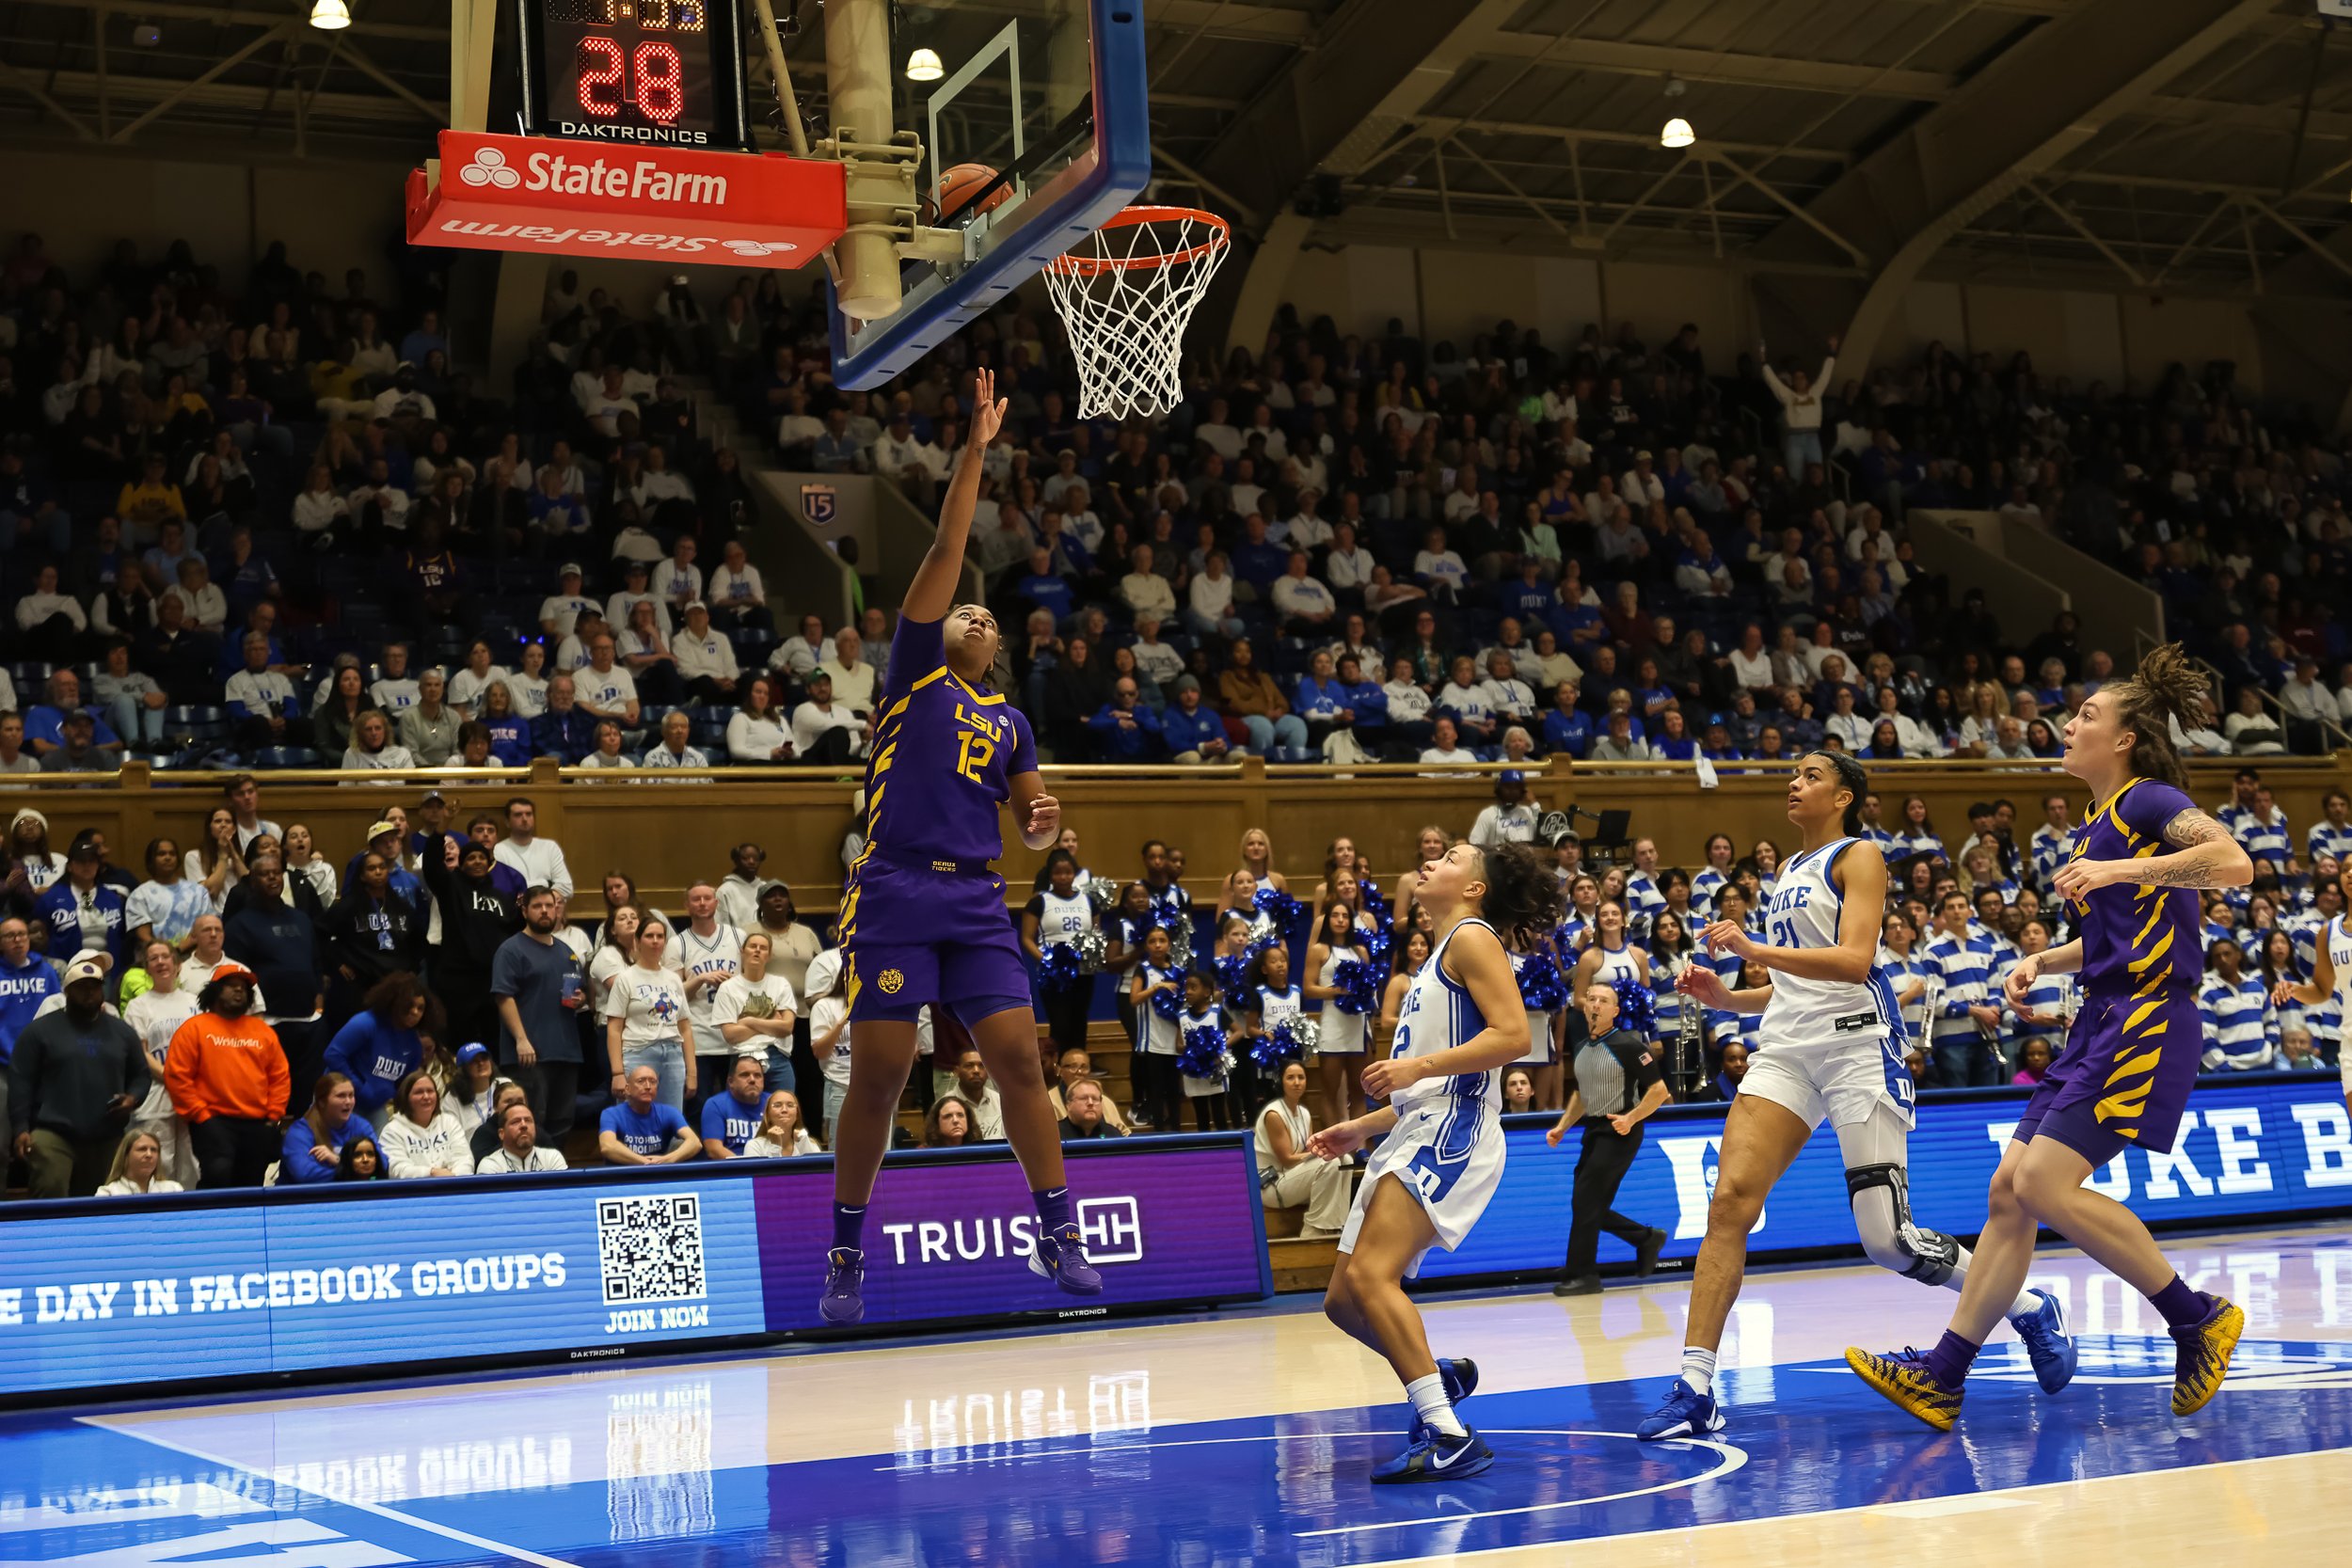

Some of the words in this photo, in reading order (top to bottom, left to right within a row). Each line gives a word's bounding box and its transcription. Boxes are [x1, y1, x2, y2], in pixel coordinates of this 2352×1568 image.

[577, 37, 682, 121] 28
[562, 122, 707, 144] DAKTRONICS
[809, 495, 832, 517] 15
[954, 703, 1002, 742] LSU
[956, 731, 995, 784] 12
[1772, 917, 1800, 948] 21
[0, 977, 46, 994] DUKE
[882, 1216, 1042, 1265] TRUIS
[36, 1281, 120, 1323] DAY
[132, 1278, 179, 1317] IN
[190, 1263, 403, 1313] FACEBOOK
[410, 1252, 566, 1299] GROUPS
[605, 1309, 655, 1334] JOIN
[660, 1305, 708, 1329] NOW
[1058, 1307, 1107, 1318] DAKTRONICS
[570, 1348, 625, 1359] DAKTRONICS
